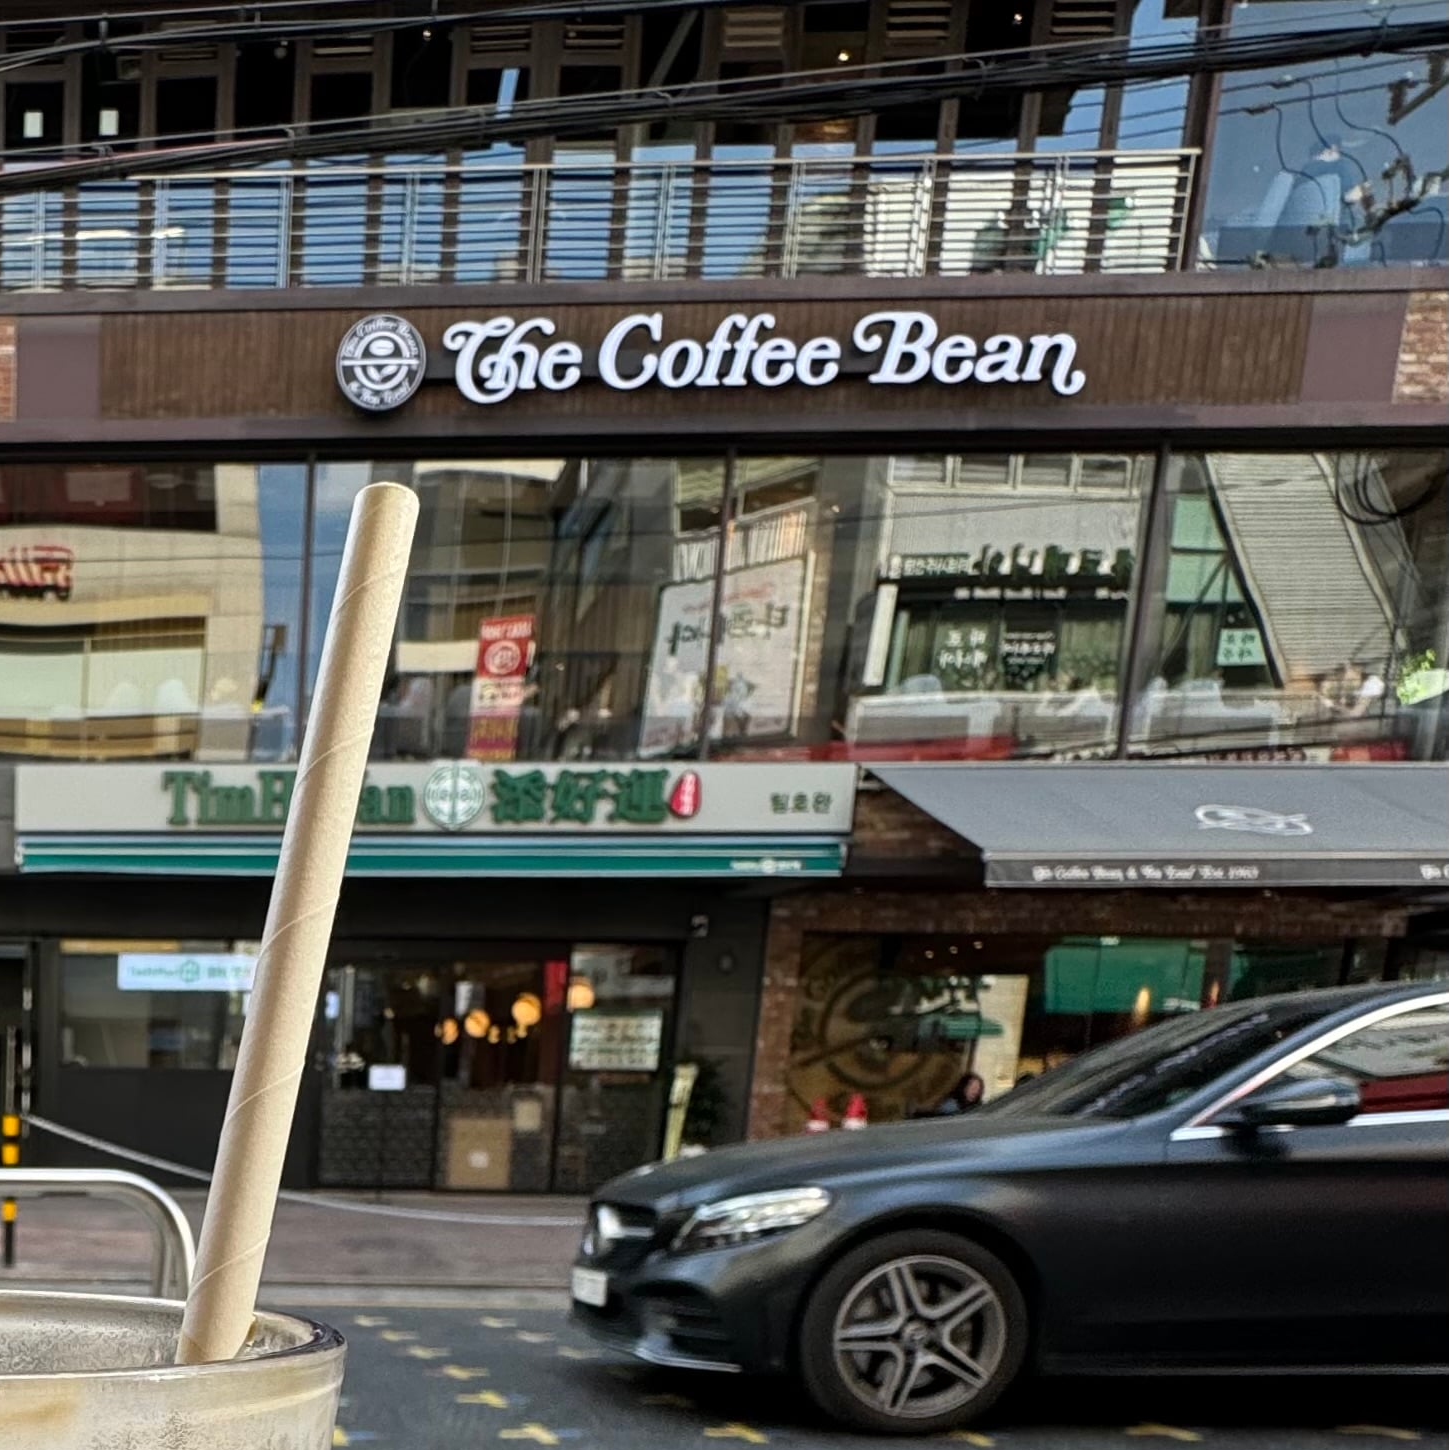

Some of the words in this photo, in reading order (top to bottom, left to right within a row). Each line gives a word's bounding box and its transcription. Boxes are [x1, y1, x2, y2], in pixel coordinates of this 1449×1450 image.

[442, 314, 583, 404] The
[597, 312, 842, 389] Coffee
[852, 311, 1087, 395] Bean
[162, 769, 416, 826] TimHan
